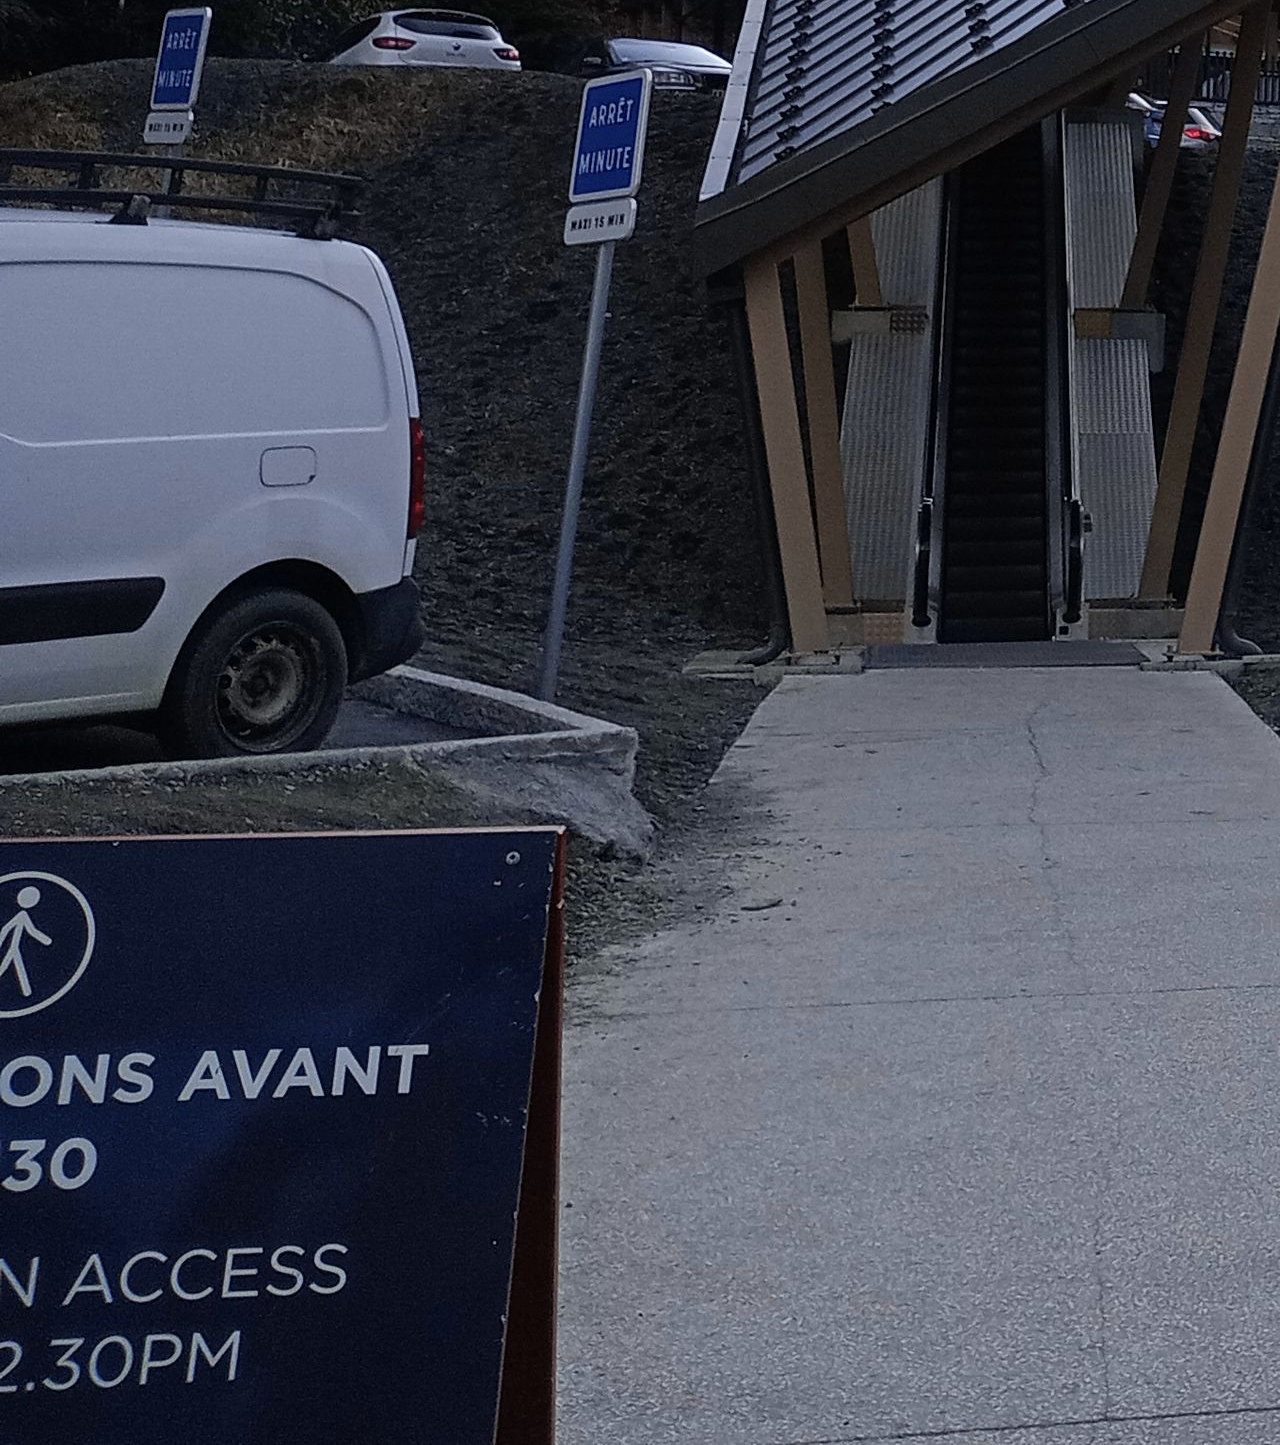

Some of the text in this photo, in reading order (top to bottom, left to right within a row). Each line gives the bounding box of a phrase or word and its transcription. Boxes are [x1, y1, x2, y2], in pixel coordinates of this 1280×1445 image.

[166, 28, 197, 50] ARRÊT
[158, 70, 192, 88] MINUTE
[589, 97, 634, 128] ARRÊT
[579, 147, 632, 175] MINUTE
[570, 213, 625, 231] MAXI 15 MIN
[0, 1044, 430, 1107] ONS AVANT
[2, 1137, 98, 1192] 30
[62, 1243, 349, 1305] ACCESS
